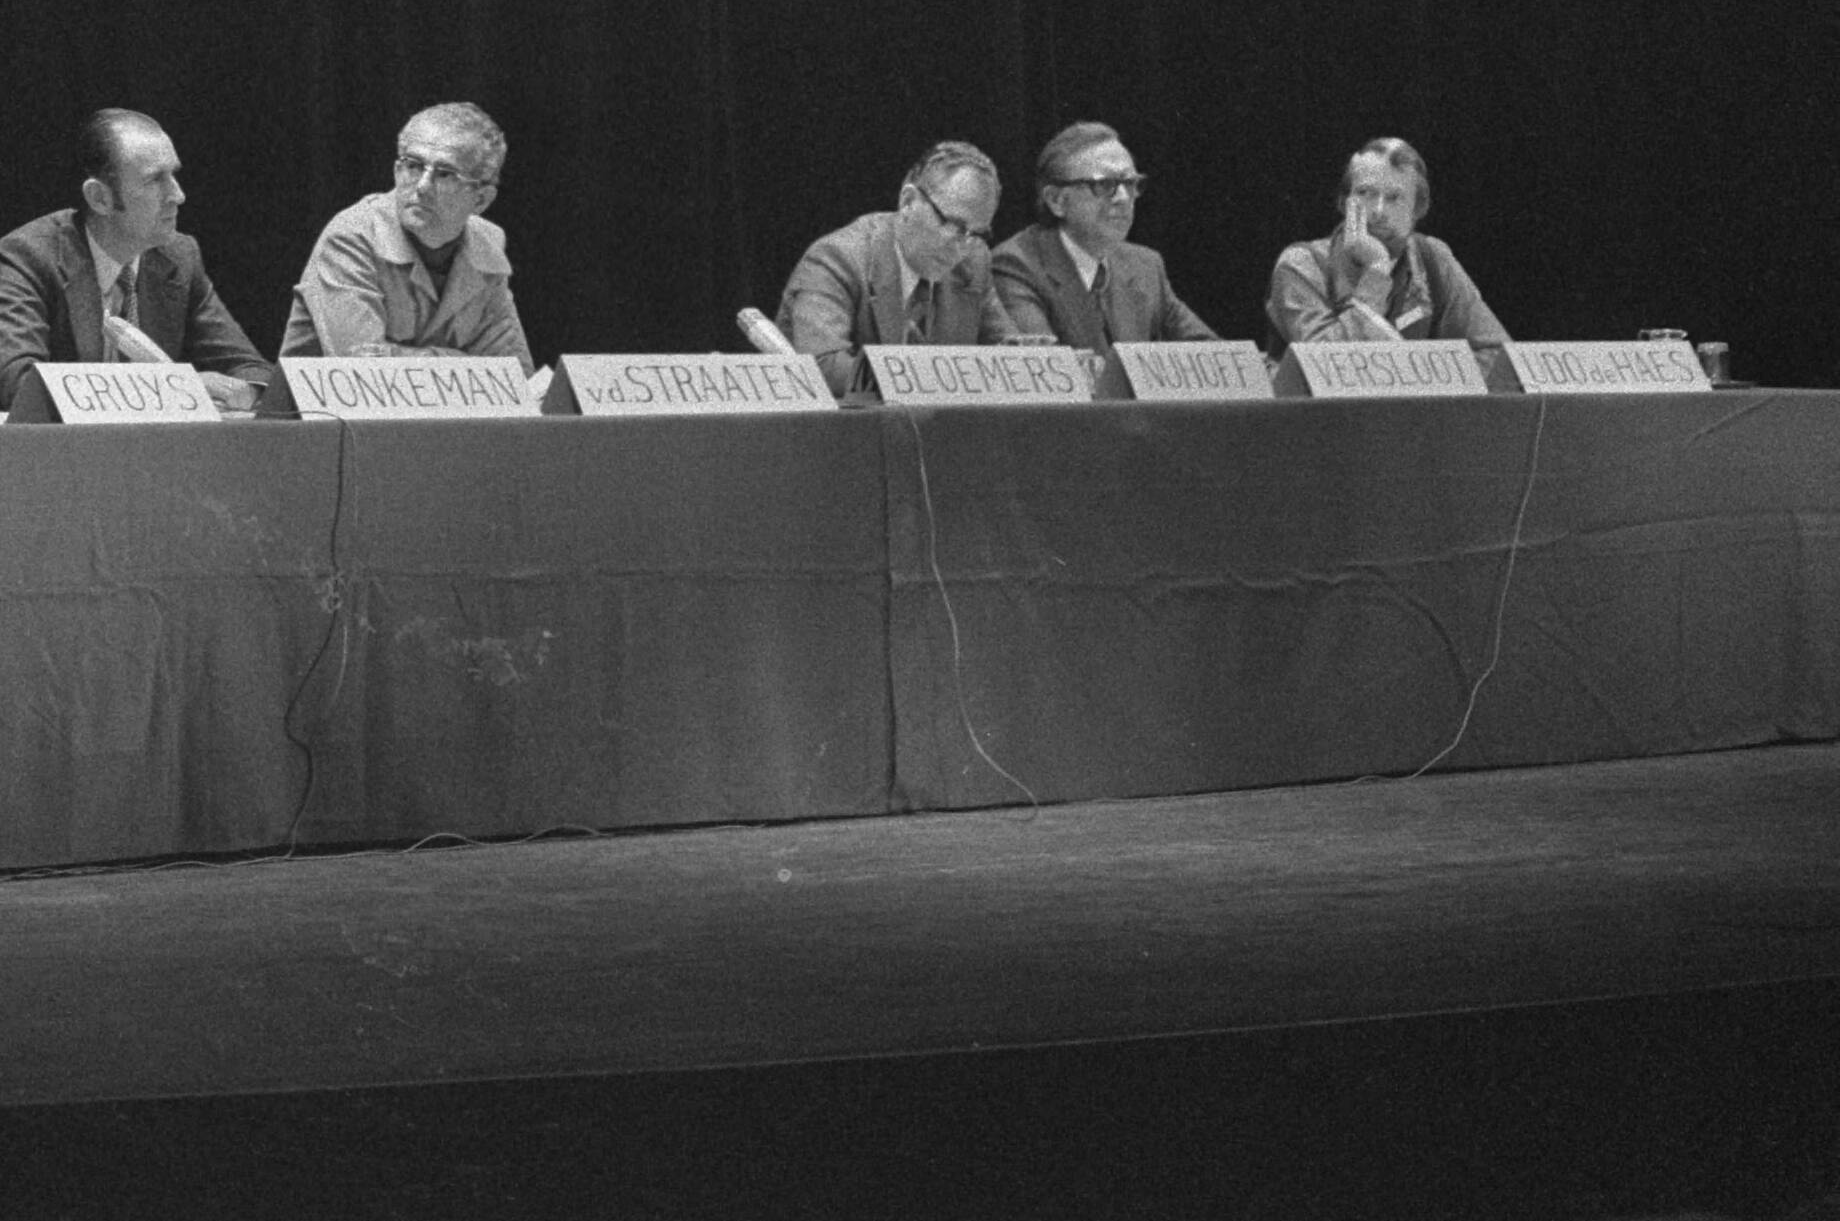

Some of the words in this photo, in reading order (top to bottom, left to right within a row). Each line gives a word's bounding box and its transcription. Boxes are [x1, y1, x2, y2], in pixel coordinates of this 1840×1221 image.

[300, 368, 522, 408] VONKEMAN
[883, 355, 1074, 394] BLOEMERS
[1308, 350, 1468, 387] VERSLOOT
[62, 372, 200, 413] GRUYS
